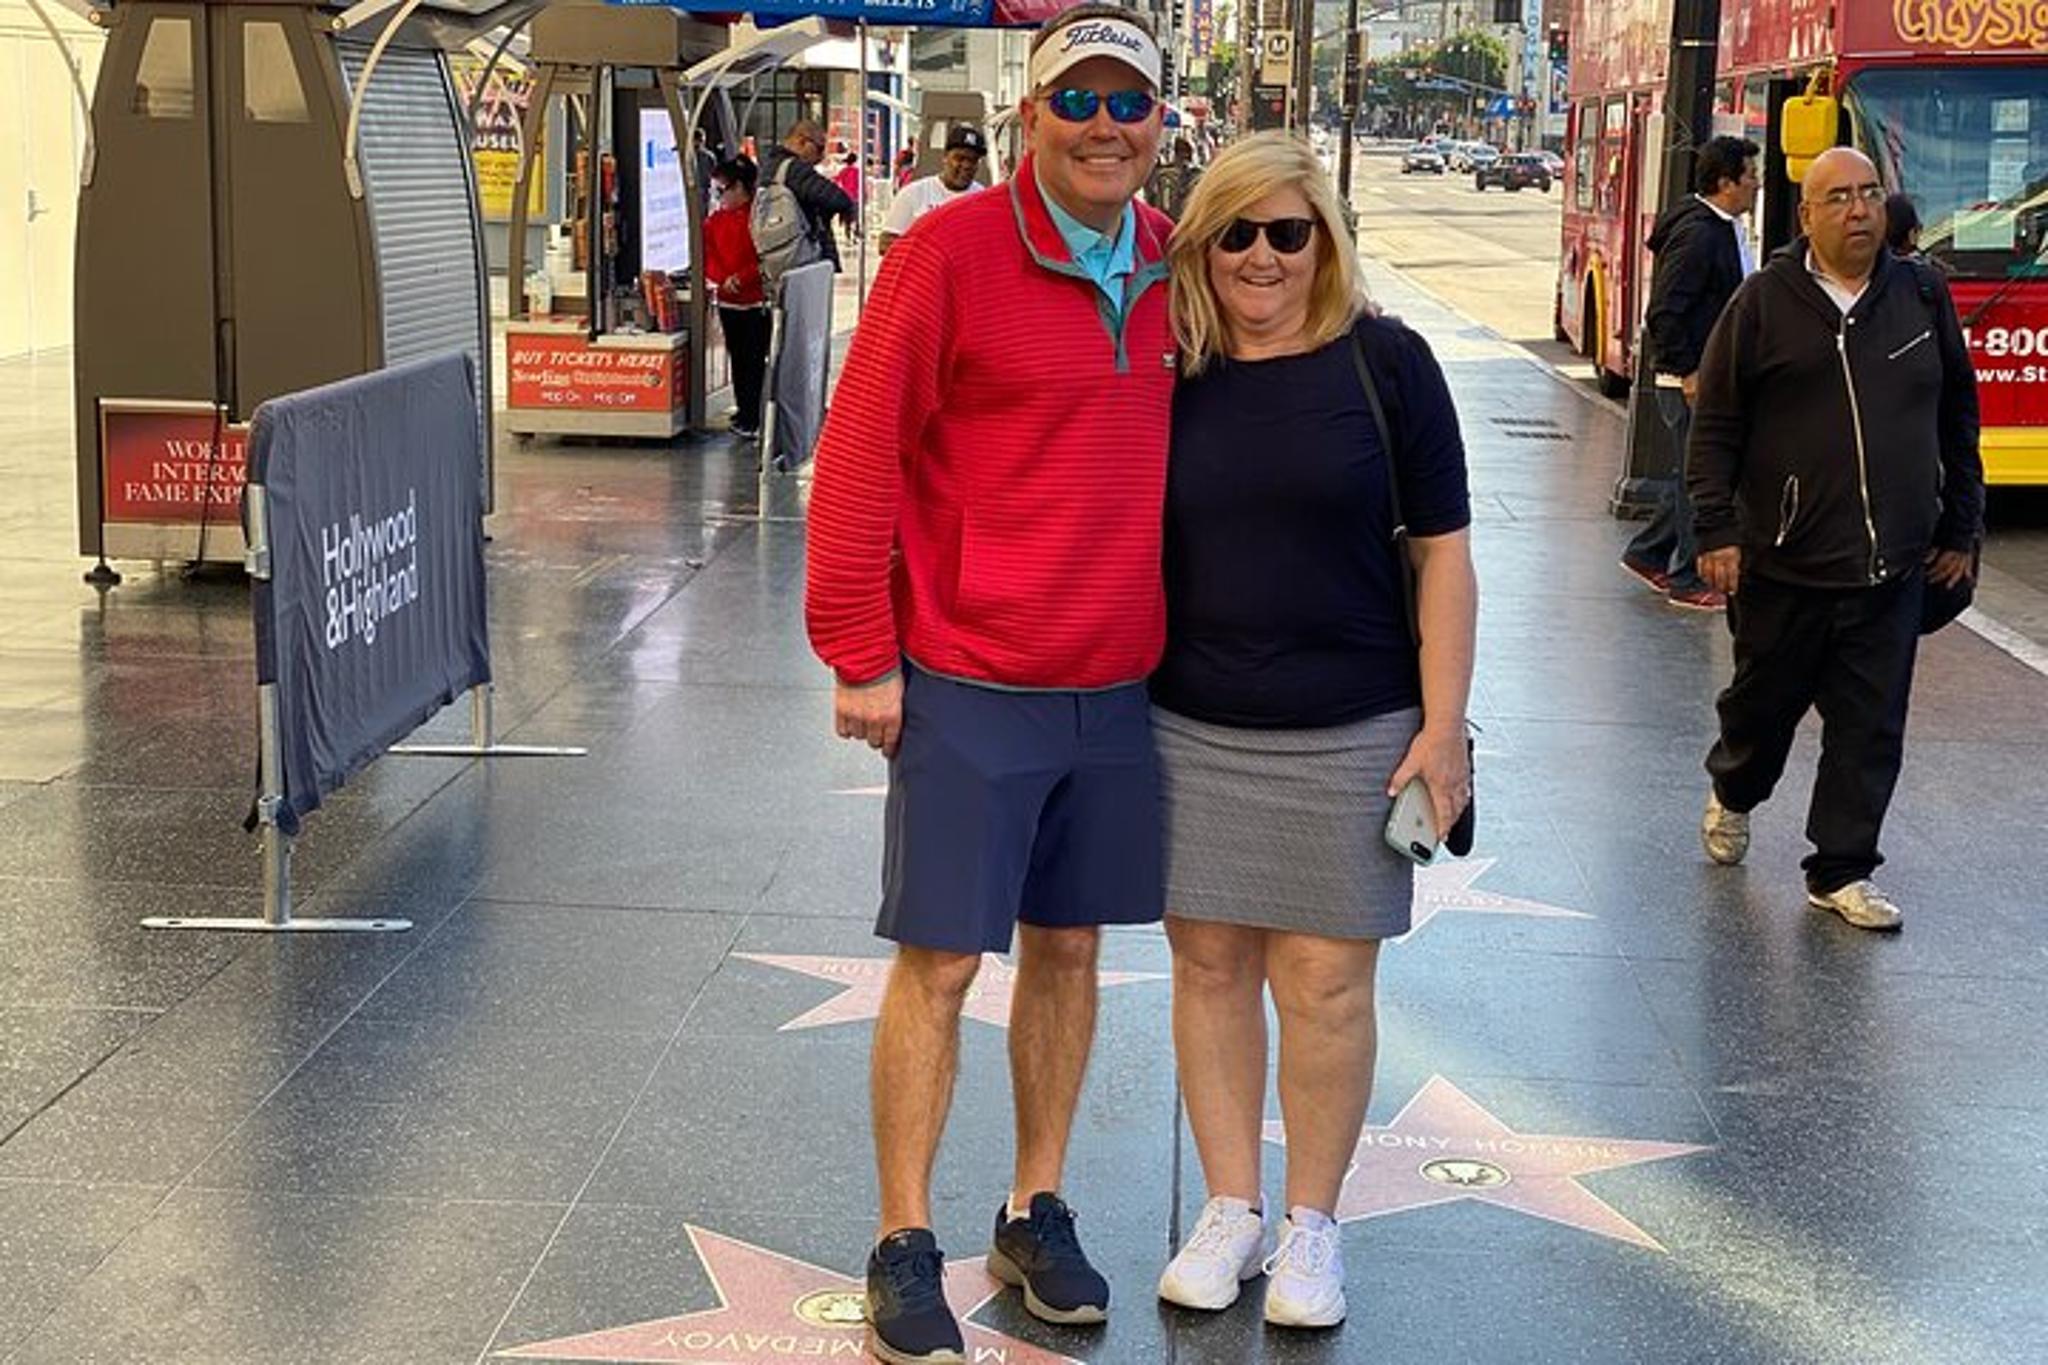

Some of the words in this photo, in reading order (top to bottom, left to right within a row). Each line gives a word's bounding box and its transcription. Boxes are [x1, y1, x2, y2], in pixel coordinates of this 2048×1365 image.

[550, 351, 613, 367] TICKETS
[125, 482, 190, 502] FAME
[321, 487, 417, 588] Hollywood
[652, 1329, 866, 1358] MEDAVOY
